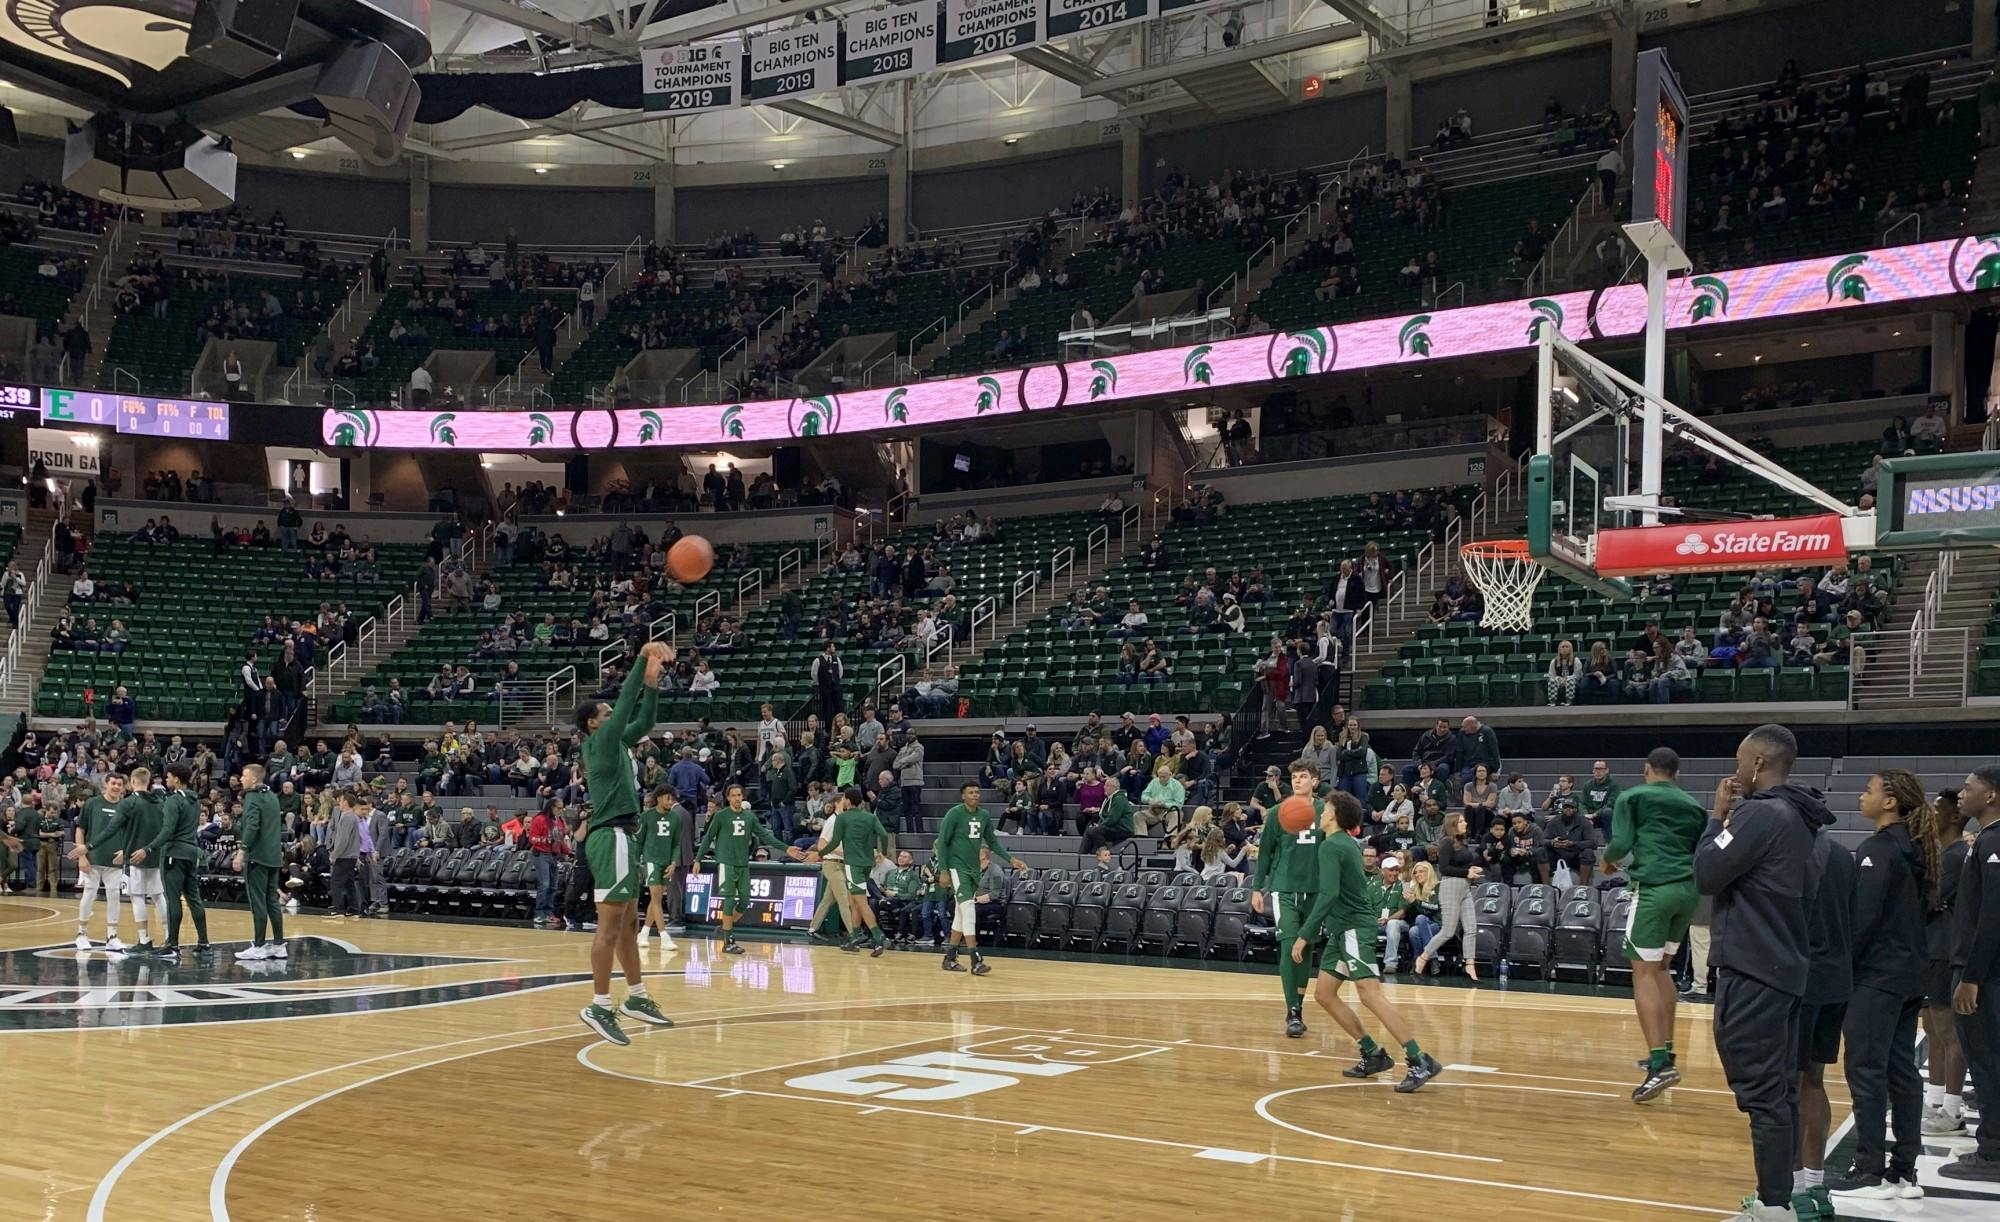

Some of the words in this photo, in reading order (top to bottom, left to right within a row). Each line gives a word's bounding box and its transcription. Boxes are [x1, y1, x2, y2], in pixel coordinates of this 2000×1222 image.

[865, 18, 888, 33] BIG
[892, 11, 918, 27] TEN
[958, 6, 1037, 36] CHAMPIONS
[1079, 1, 1127, 29] 2014
[1645, 8, 1667, 22] 228
[769, 41, 791, 54] BIG
[794, 33, 819, 47] TEN
[850, 24, 934, 53] CHAMPIONS
[973, 28, 1017, 55] 2016
[655, 61, 731, 76] TOURNAMENT
[754, 46, 835, 73] CHAMPIONS
[872, 52, 909, 73] 2018
[654, 73, 731, 90] CHAMPIONS
[776, 72, 811, 93] 2019
[669, 89, 713, 109] 2019
[1103, 125, 1121, 136] 226
[340, 158, 359, 169] 223
[868, 159, 886, 169] 225
[633, 171, 651, 182] 224
[48, 389, 74, 419] E
[90, 398, 103, 421] 0
[157, 403, 179, 417] FT%
[189, 405, 197, 417] F
[207, 406, 225, 420] TOL
[130, 416, 137, 430] 0
[163, 420, 170, 433] 0
[189, 422, 203, 435] 00
[214, 423, 222, 435] 4
[79, 455, 100, 470] GA
[1469, 462, 1485, 472] 128
[657, 820, 670, 837] E
[732, 820, 745, 836] E
[968, 821, 981, 839] E
[687, 883, 704, 893] STATE
[690, 894, 699, 913] 0
[795, 899, 803, 918] 0
[1347, 959, 1358, 972] E
